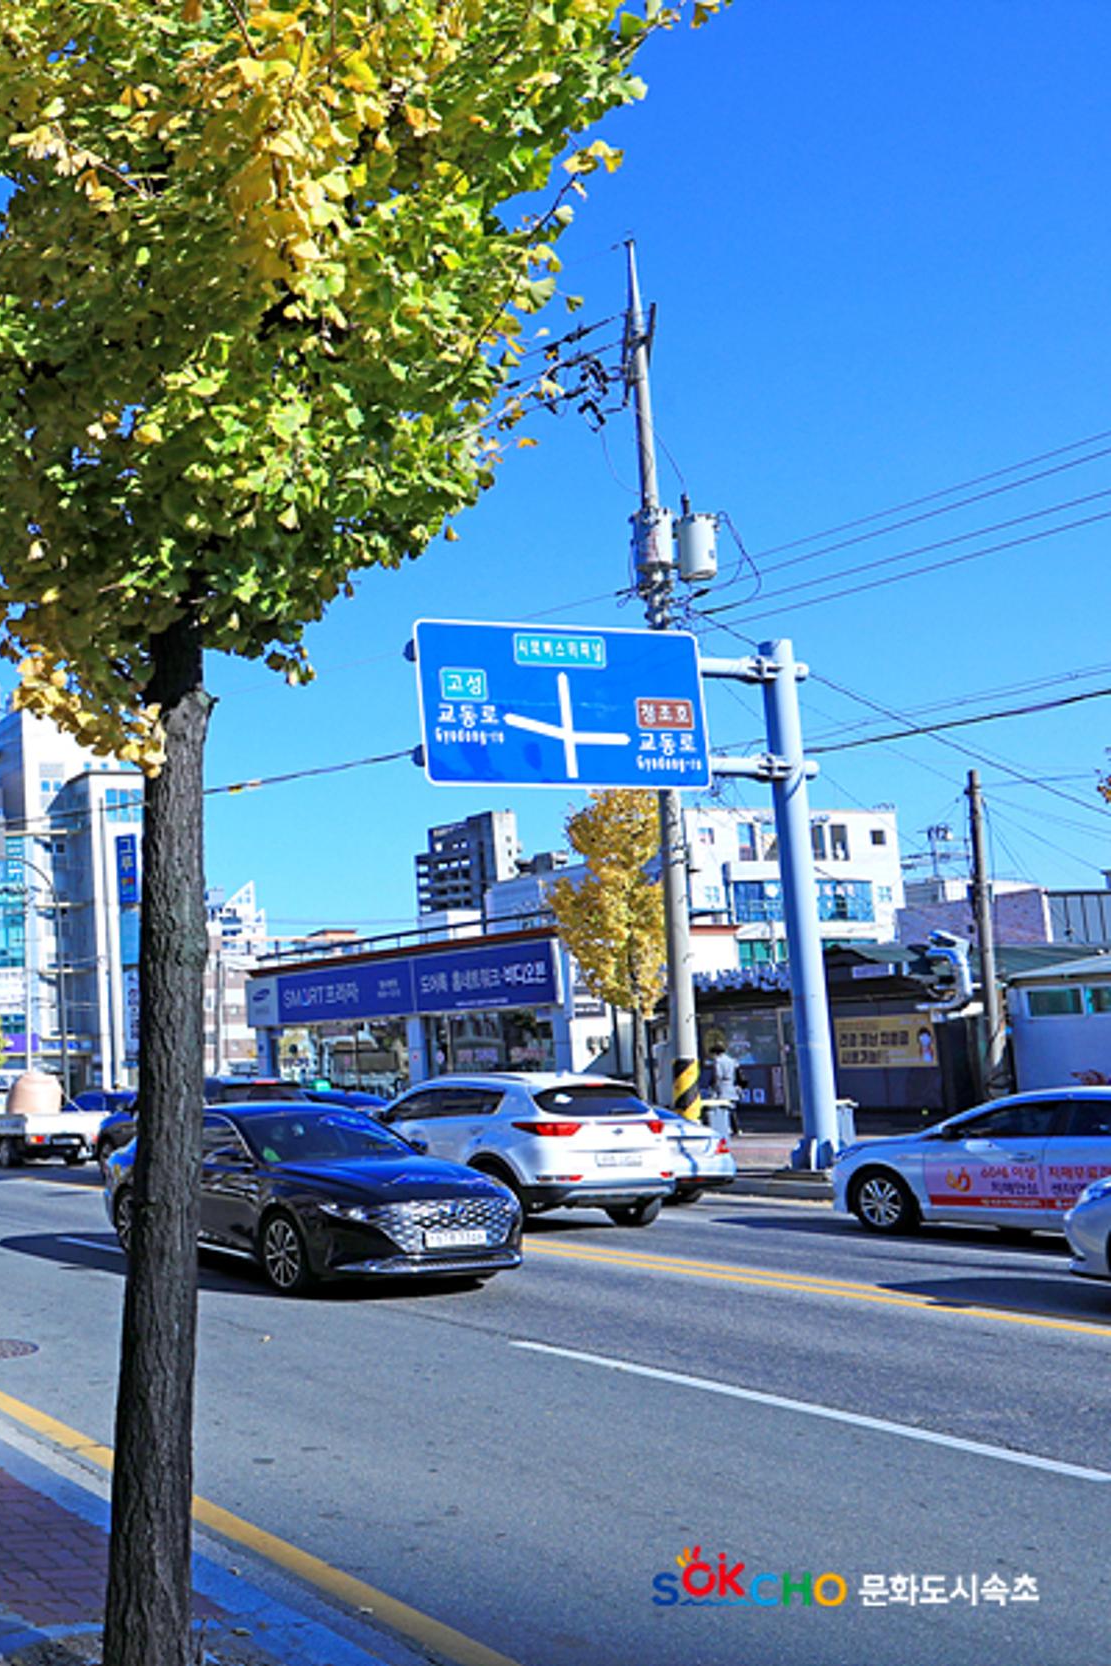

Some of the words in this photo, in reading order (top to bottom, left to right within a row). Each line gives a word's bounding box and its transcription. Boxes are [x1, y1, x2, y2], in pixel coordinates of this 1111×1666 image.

[447, 674, 482, 696] 고성
[437, 703, 500, 728] 교동로
[435, 727, 505, 746] Gyodong-ro
[638, 732, 697, 756] 교동로
[636, 755, 702, 773] Gyodong-ro
